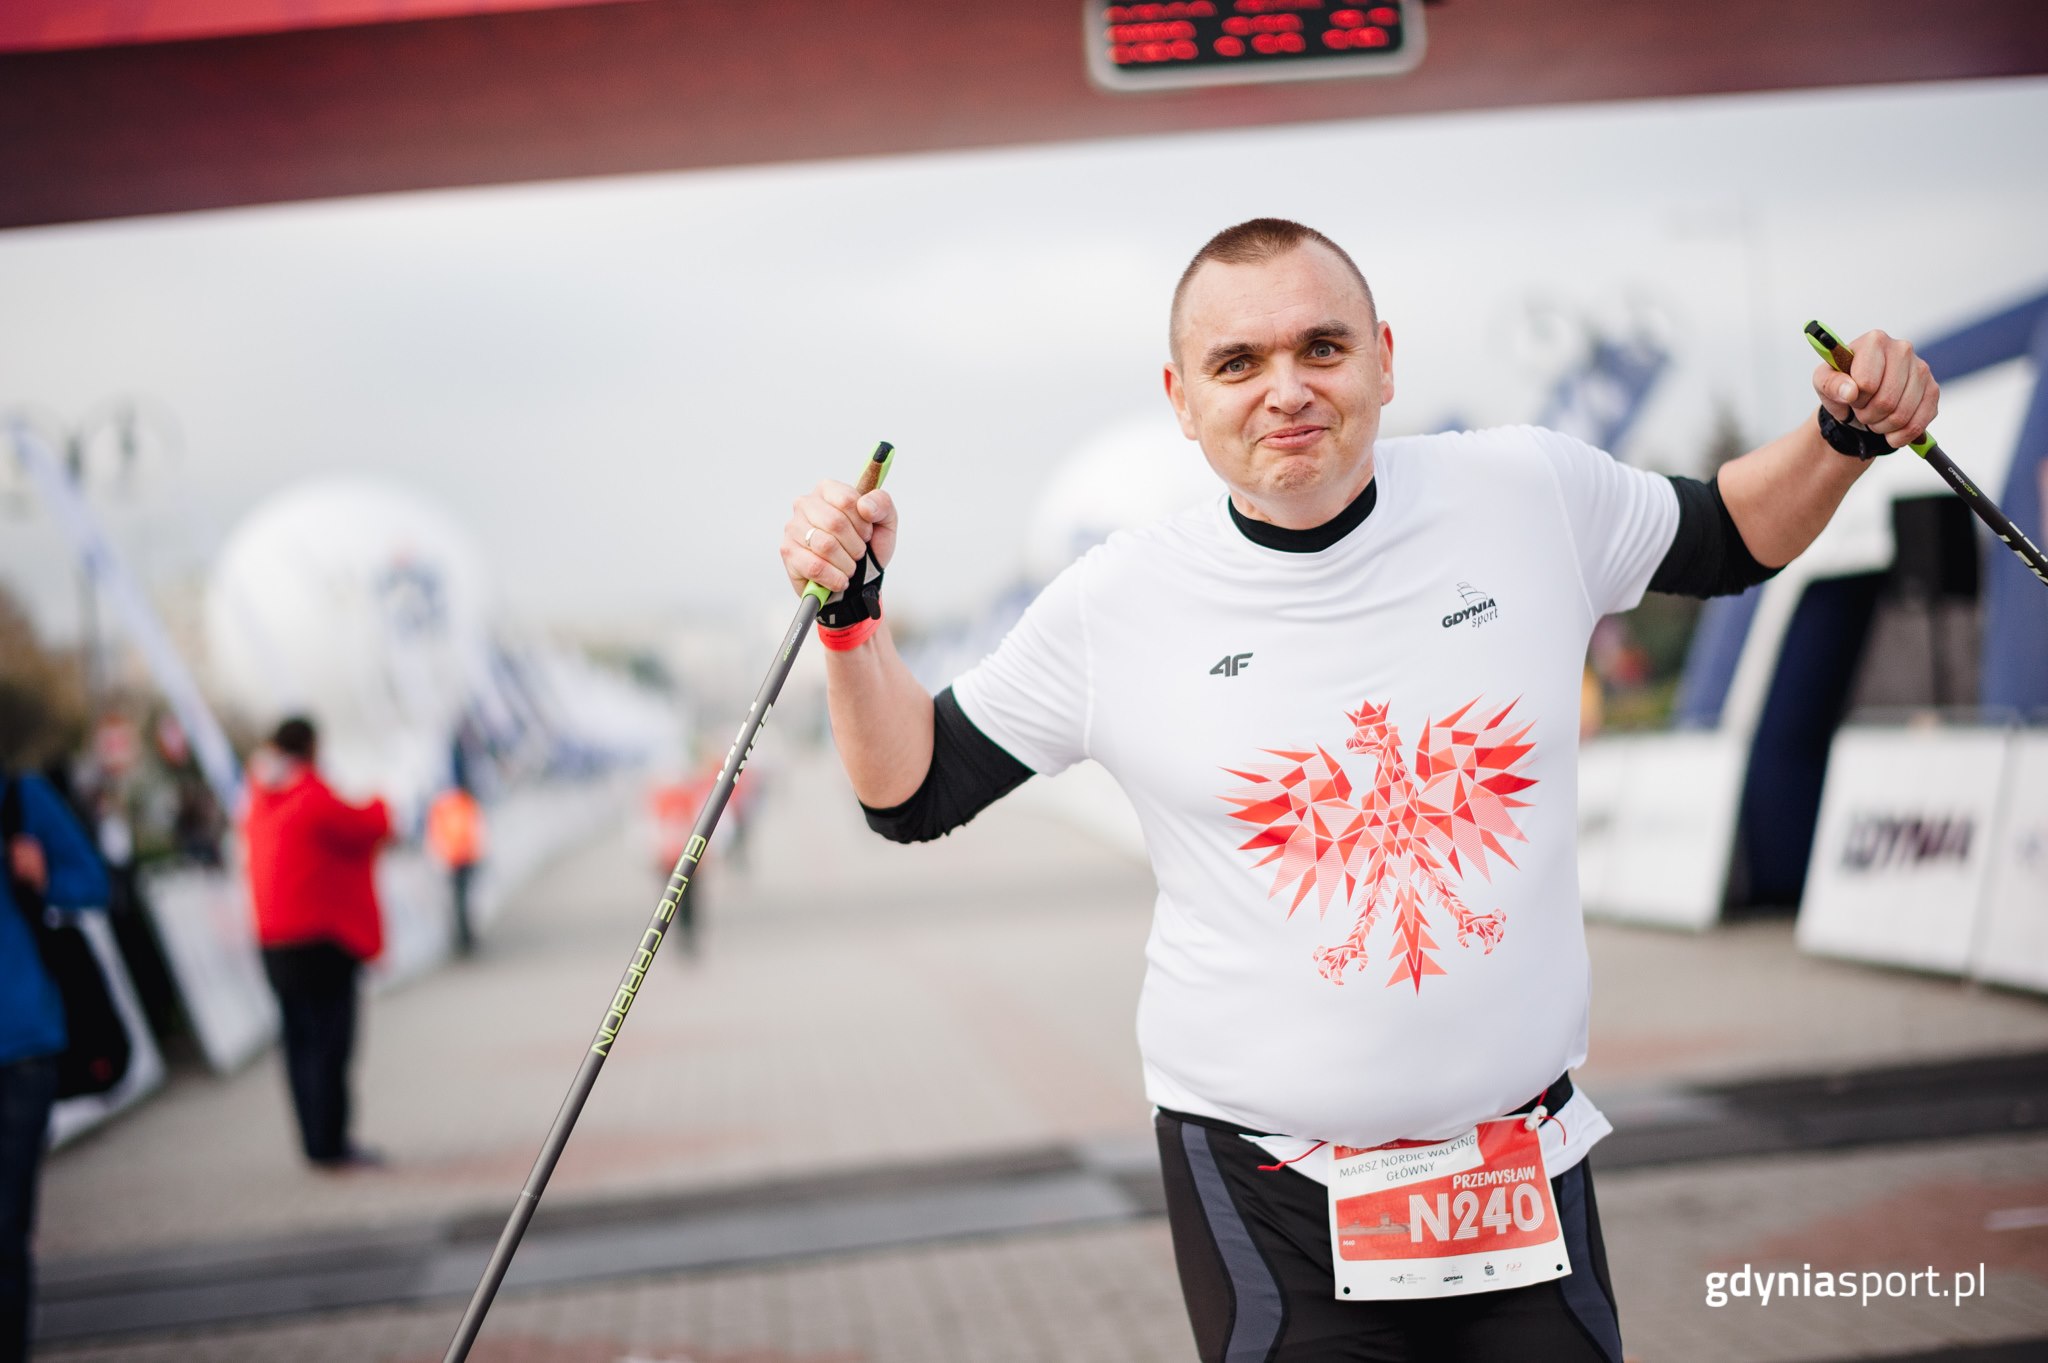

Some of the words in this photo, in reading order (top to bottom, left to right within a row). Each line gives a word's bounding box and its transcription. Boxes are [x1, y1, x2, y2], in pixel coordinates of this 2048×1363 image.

[1442, 598, 1496, 628] GDYNIA
[1472, 606, 1498, 629] sport
[1209, 652, 1254, 677] 4F
[655, 834, 706, 923] ELITE
[591, 928, 662, 1057] CARBON
[1339, 1160, 1378, 1178] MARSZ
[1381, 1152, 1424, 1168] NORDIC
[1427, 1134, 1476, 1158] WALKING
[1386, 1162, 1435, 1182] GŁÓWNY
[1453, 1165, 1536, 1190] PRZEMYSŁAW
[1409, 1183, 1545, 1243] N240
